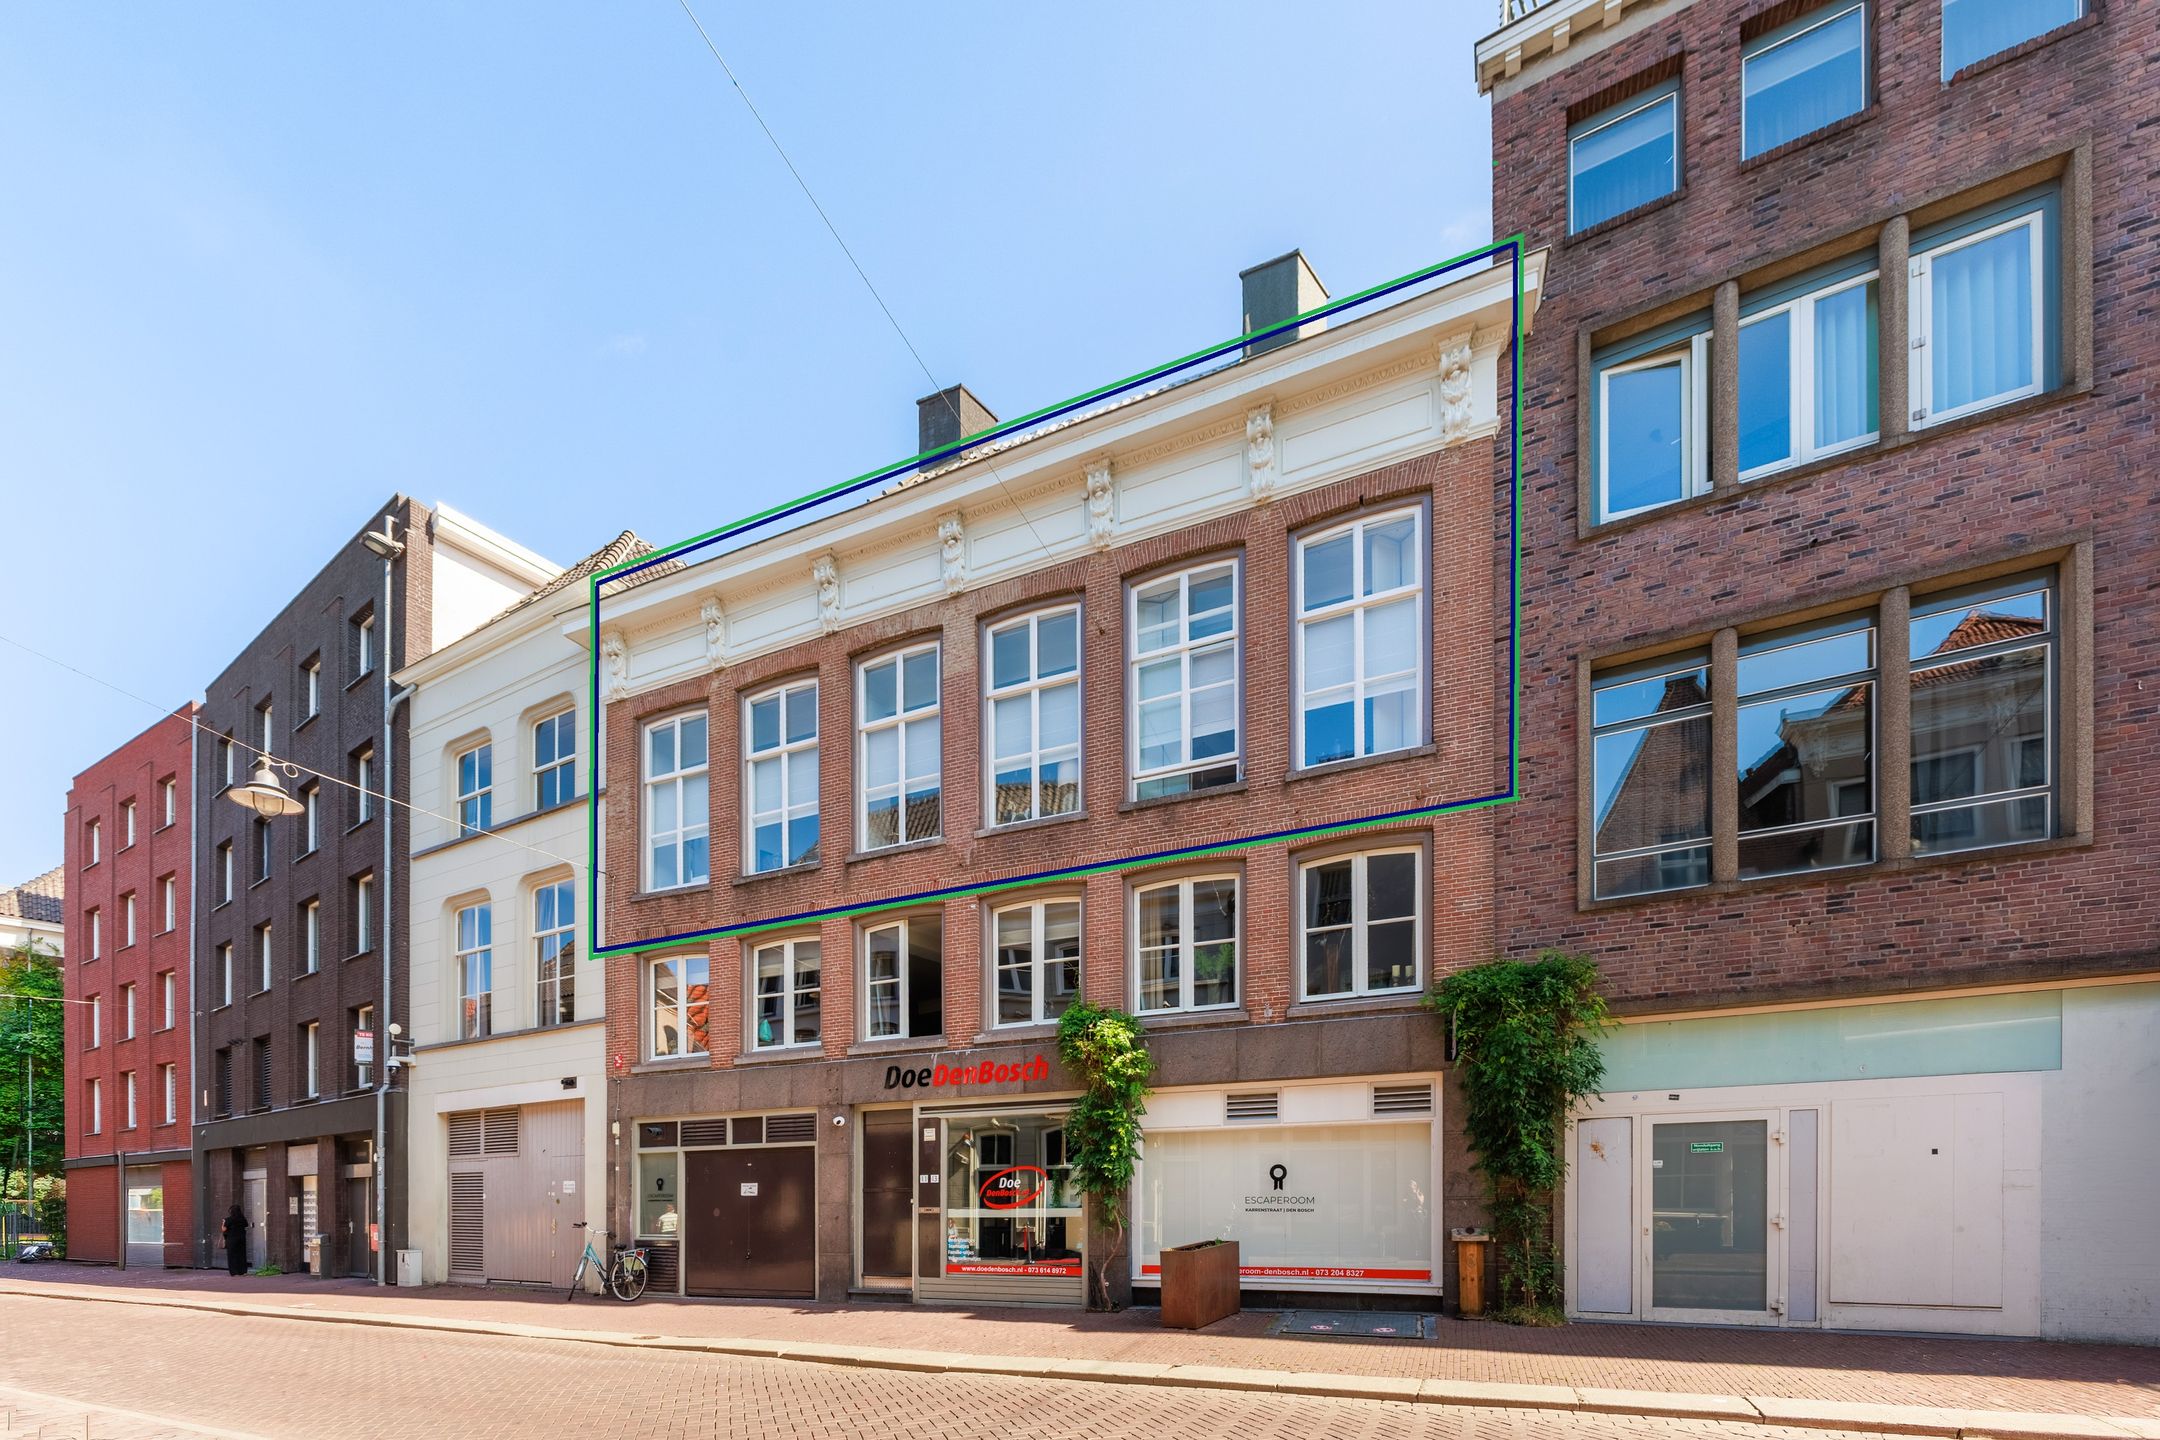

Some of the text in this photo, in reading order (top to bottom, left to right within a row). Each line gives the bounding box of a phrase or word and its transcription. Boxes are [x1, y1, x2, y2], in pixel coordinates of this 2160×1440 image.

[884, 1054, 1049, 1090] DoeDenBosch
[998, 1177, 1021, 1189] Doe
[1244, 1196, 1315, 1204] ESCAPEROOM
[961, 1265, 1024, 1274] www.doedenbosch.nl
[1051, 1267, 1067, 1275] 8972
[1330, 1269, 1344, 1277] 204
[1345, 1269, 1365, 1277] 8327
